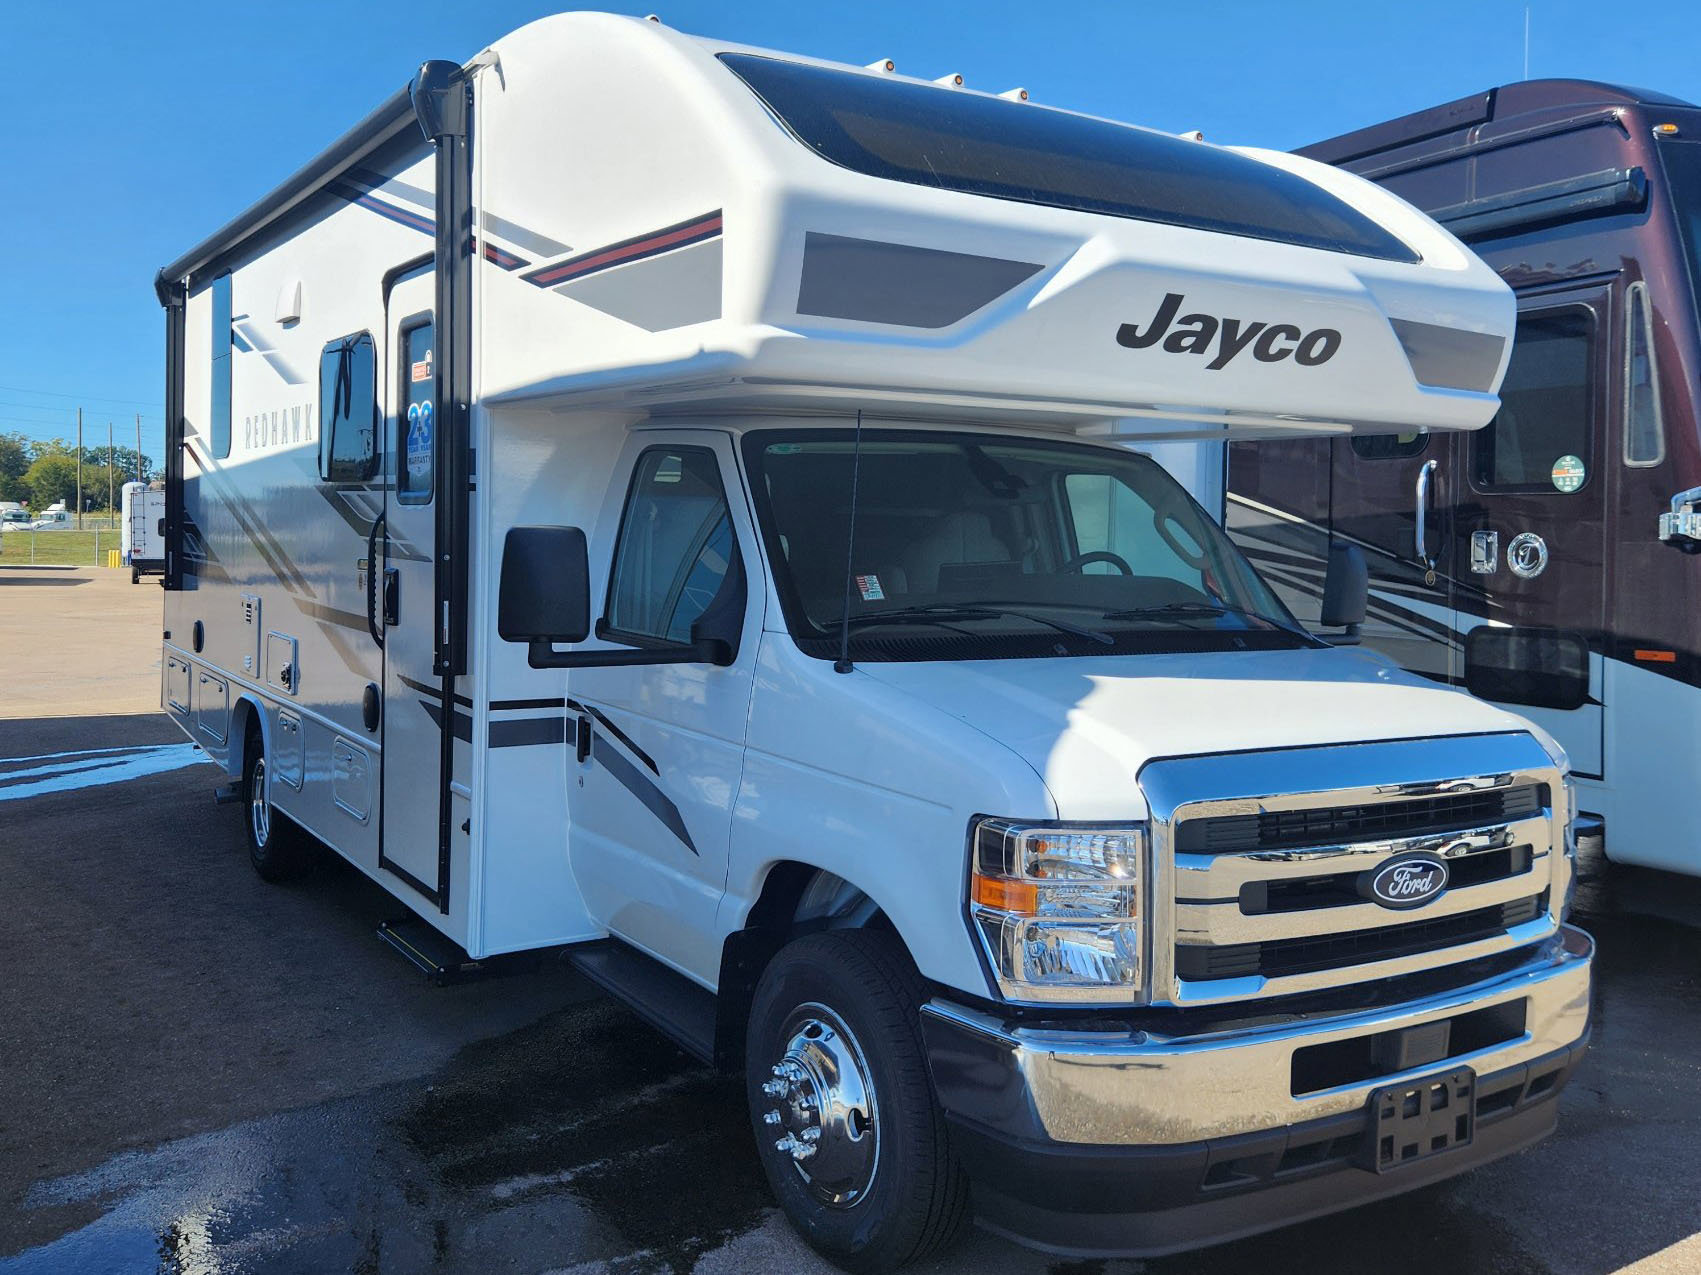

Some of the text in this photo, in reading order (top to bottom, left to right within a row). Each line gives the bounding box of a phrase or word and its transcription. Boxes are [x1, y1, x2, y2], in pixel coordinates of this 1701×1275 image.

[1116, 292, 1342, 370] Jayco
[245, 403, 312, 449] REDHAWK
[1388, 866, 1434, 896] Ford
